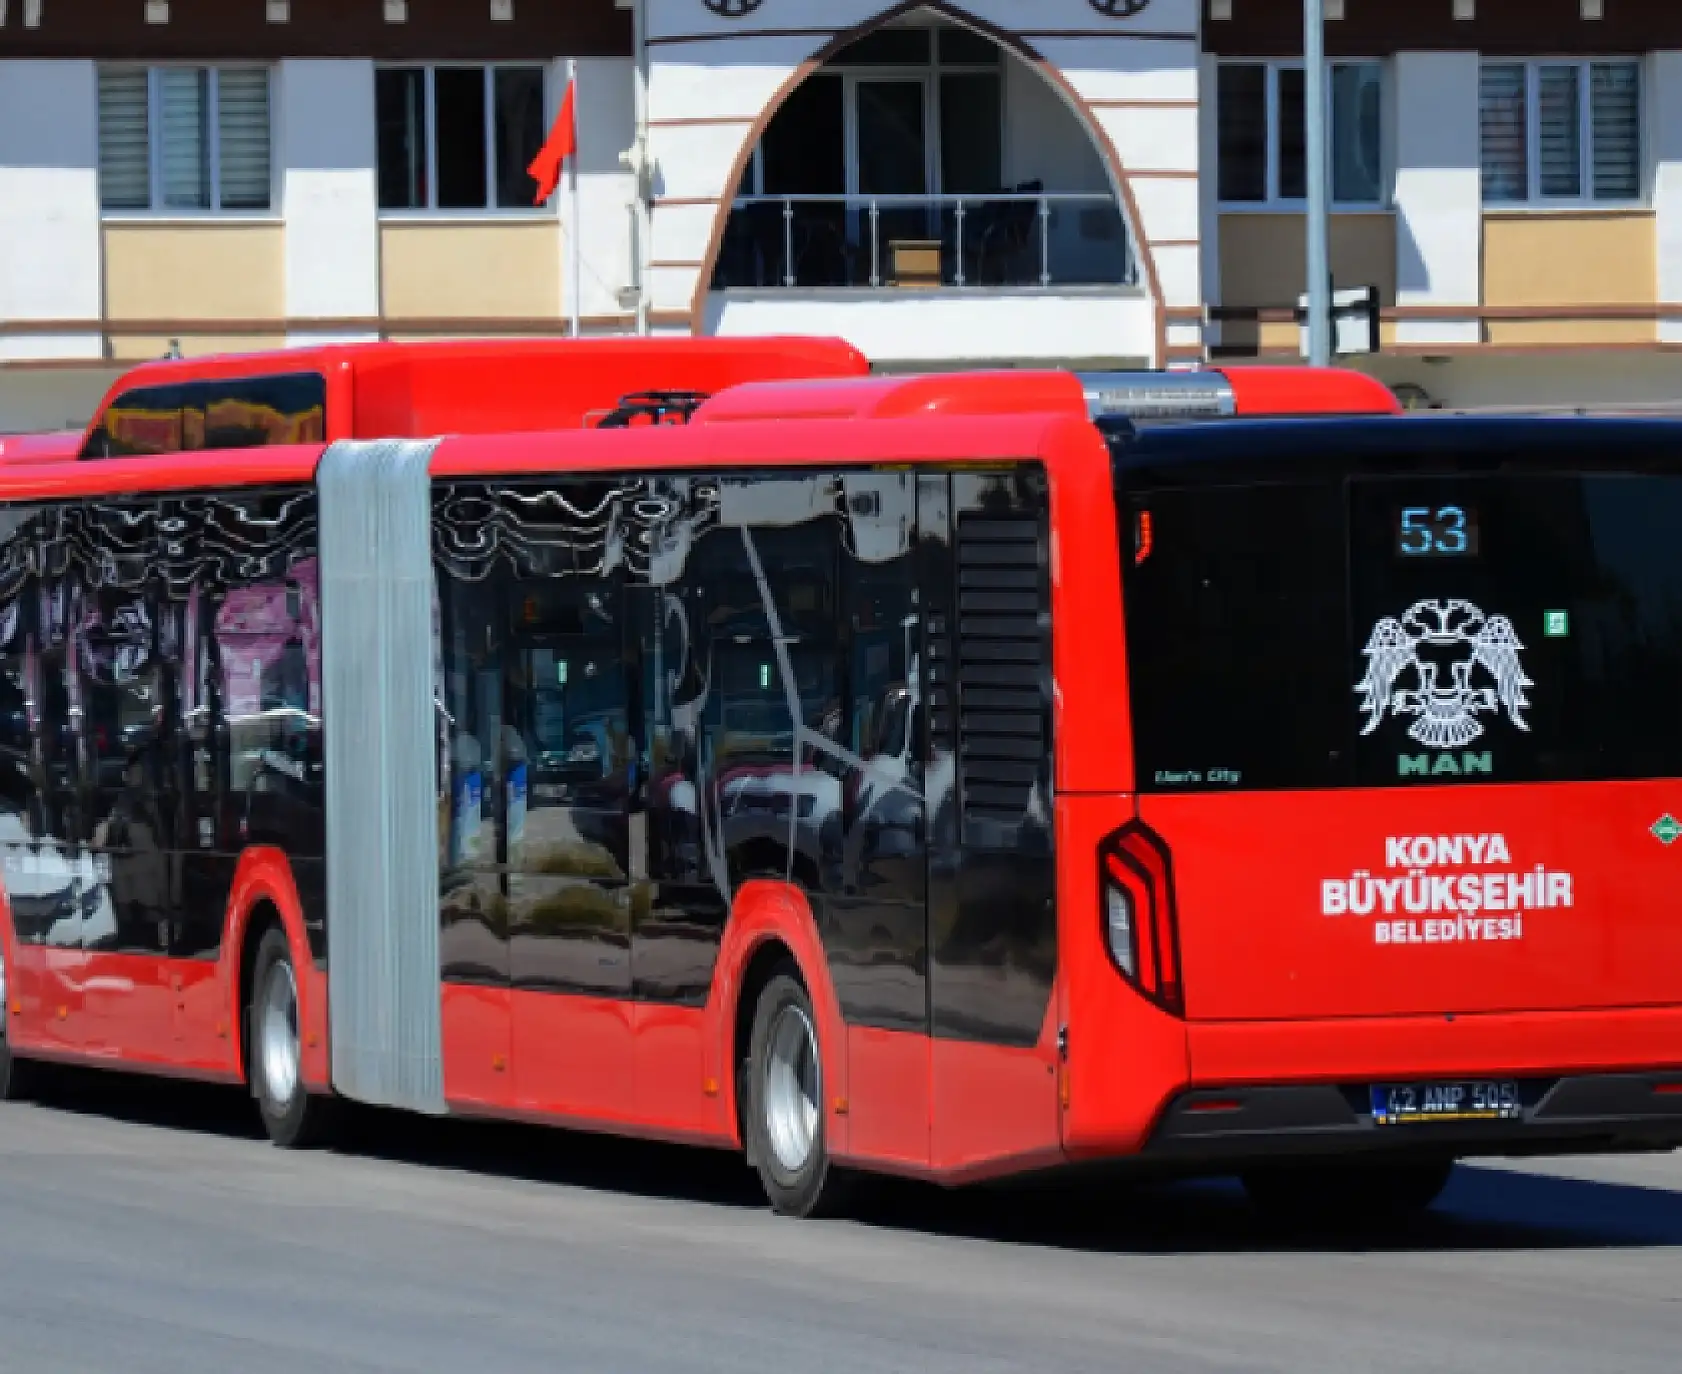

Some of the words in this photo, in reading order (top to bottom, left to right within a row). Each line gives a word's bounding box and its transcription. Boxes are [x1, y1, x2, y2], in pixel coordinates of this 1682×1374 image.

[1401, 507, 1467, 553] 53
[1398, 752, 1493, 775] MAN
[1385, 833, 1512, 867] KONYA
[1322, 863, 1574, 916] BÜYÜKŞEHİR
[1375, 912, 1522, 943] BELEDİYESİ
